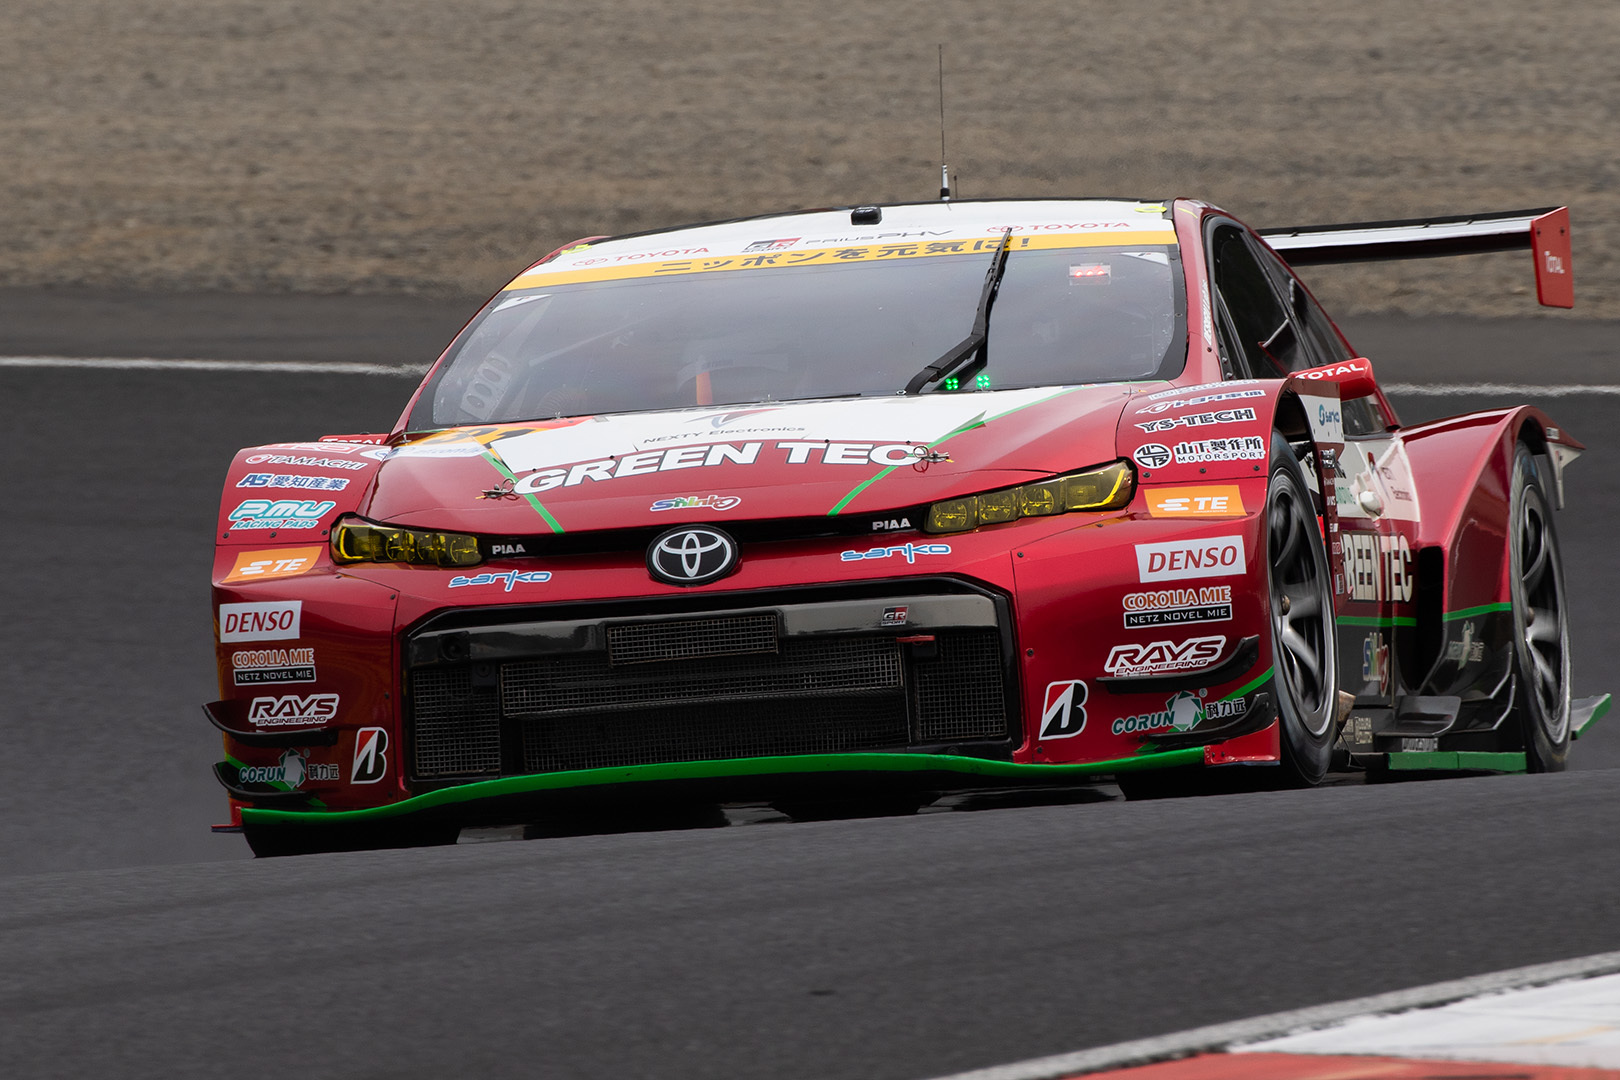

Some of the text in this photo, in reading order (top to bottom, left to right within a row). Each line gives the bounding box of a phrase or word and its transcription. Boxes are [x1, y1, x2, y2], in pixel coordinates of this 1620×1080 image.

[1029, 222, 1130, 231] TOYOTA
[613, 247, 709, 262] TOYOTA
[1296, 363, 1365, 380] TOTAL
[1136, 408, 1256, 433] YS-TECH
[643, 427, 806, 443] NEXTY Electronics
[1174, 436, 1263, 455] 山下製作所
[268, 455, 368, 470] TAMACHI
[1177, 450, 1264, 463] MOTORSPORT
[513, 440, 927, 495] GREEN TEC
[1194, 496, 1228, 510] TE
[232, 520, 318, 529] RACING PADS
[872, 517, 911, 531] PIAA
[492, 543, 526, 555] PIAA
[841, 543, 951, 564] sanko
[271, 558, 307, 572] TE
[1147, 545, 1238, 574] DENSO
[1381, 533, 1412, 602] TEC
[448, 570, 552, 592] sanko
[1123, 586, 1231, 611] COROLLA MIE
[225, 609, 294, 634] DENSO
[884, 611, 906, 620] GR
[1130, 608, 1228, 624] NETZ NOVEL MIE
[232, 648, 315, 668] COROLLA MIE
[1106, 637, 1225, 670] RAYS
[1116, 659, 1208, 673] ENGINEERING
[237, 669, 312, 681] NETZ NOVEL MIE
[250, 694, 339, 719] RAYS
[1205, 698, 1246, 719] 科力远
[257, 715, 327, 725] ENGINEERING
[1112, 711, 1175, 735] CORUN
[239, 767, 286, 783] CORUN
